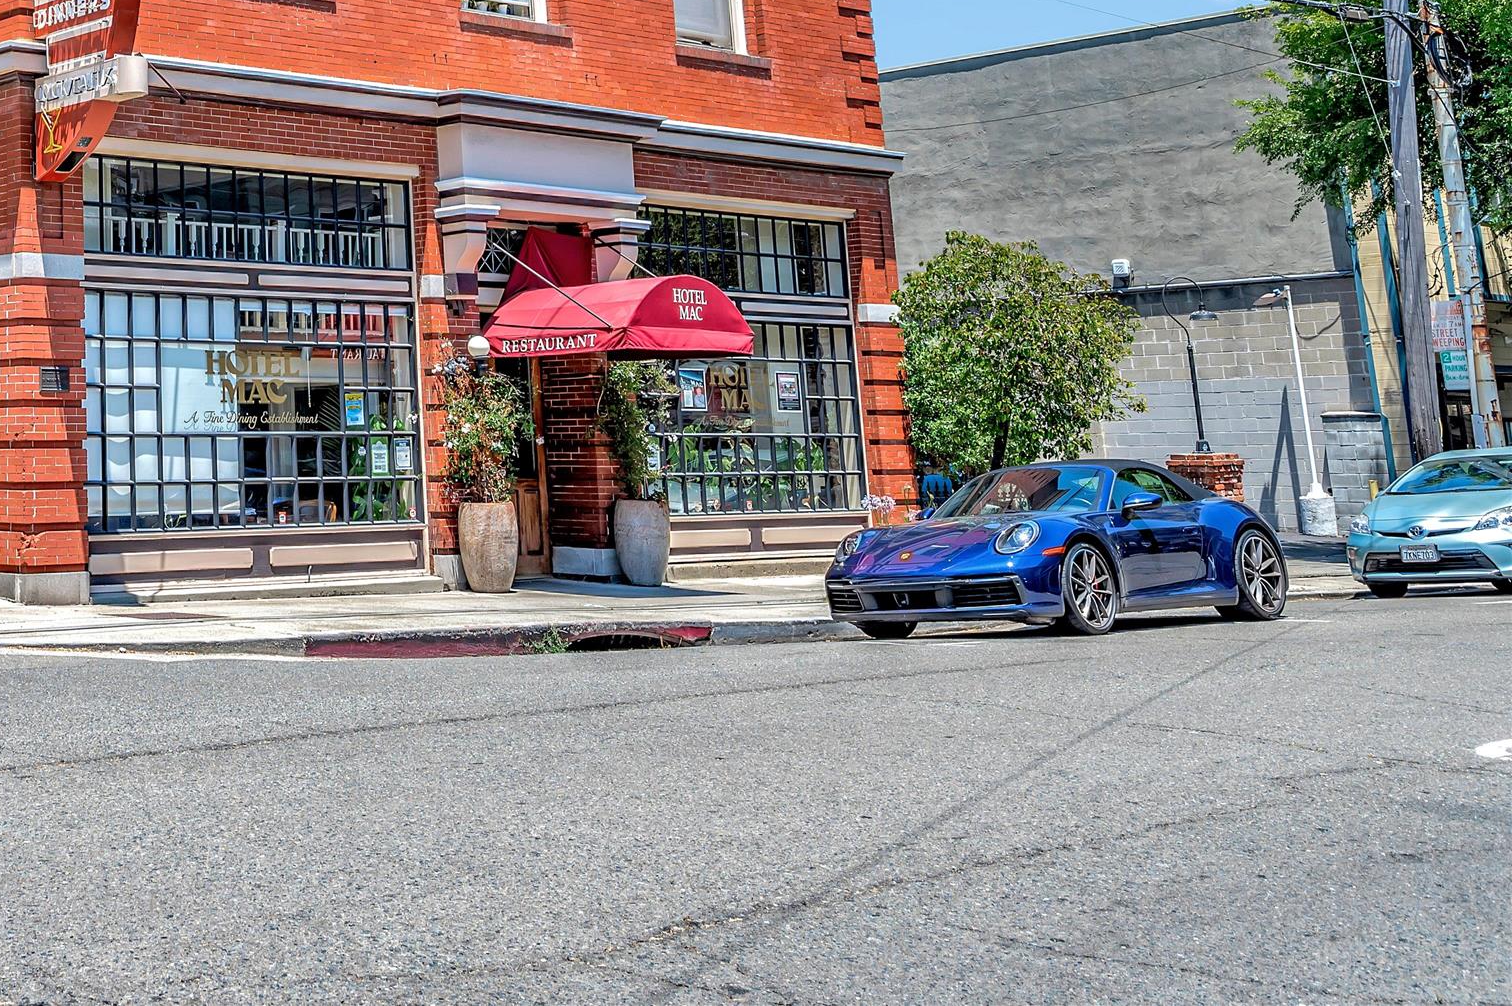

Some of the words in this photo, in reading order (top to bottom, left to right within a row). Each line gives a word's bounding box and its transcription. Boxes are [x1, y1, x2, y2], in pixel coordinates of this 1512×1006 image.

[672, 287, 708, 305] HOTEL
[679, 305, 704, 321] MAC
[1431, 328, 1458, 338] STREET
[1432, 337, 1465, 347] WEEPING
[502, 334, 598, 354] RESTAURANT
[204, 349, 300, 377] HOTEL
[1445, 364, 1468, 372] PARKING
[220, 378, 288, 405] MAC
[184, 410, 199, 424] A
[203, 410, 224, 424] Fine
[226, 410, 258, 429] Dining
[260, 410, 319, 425] Establishment
